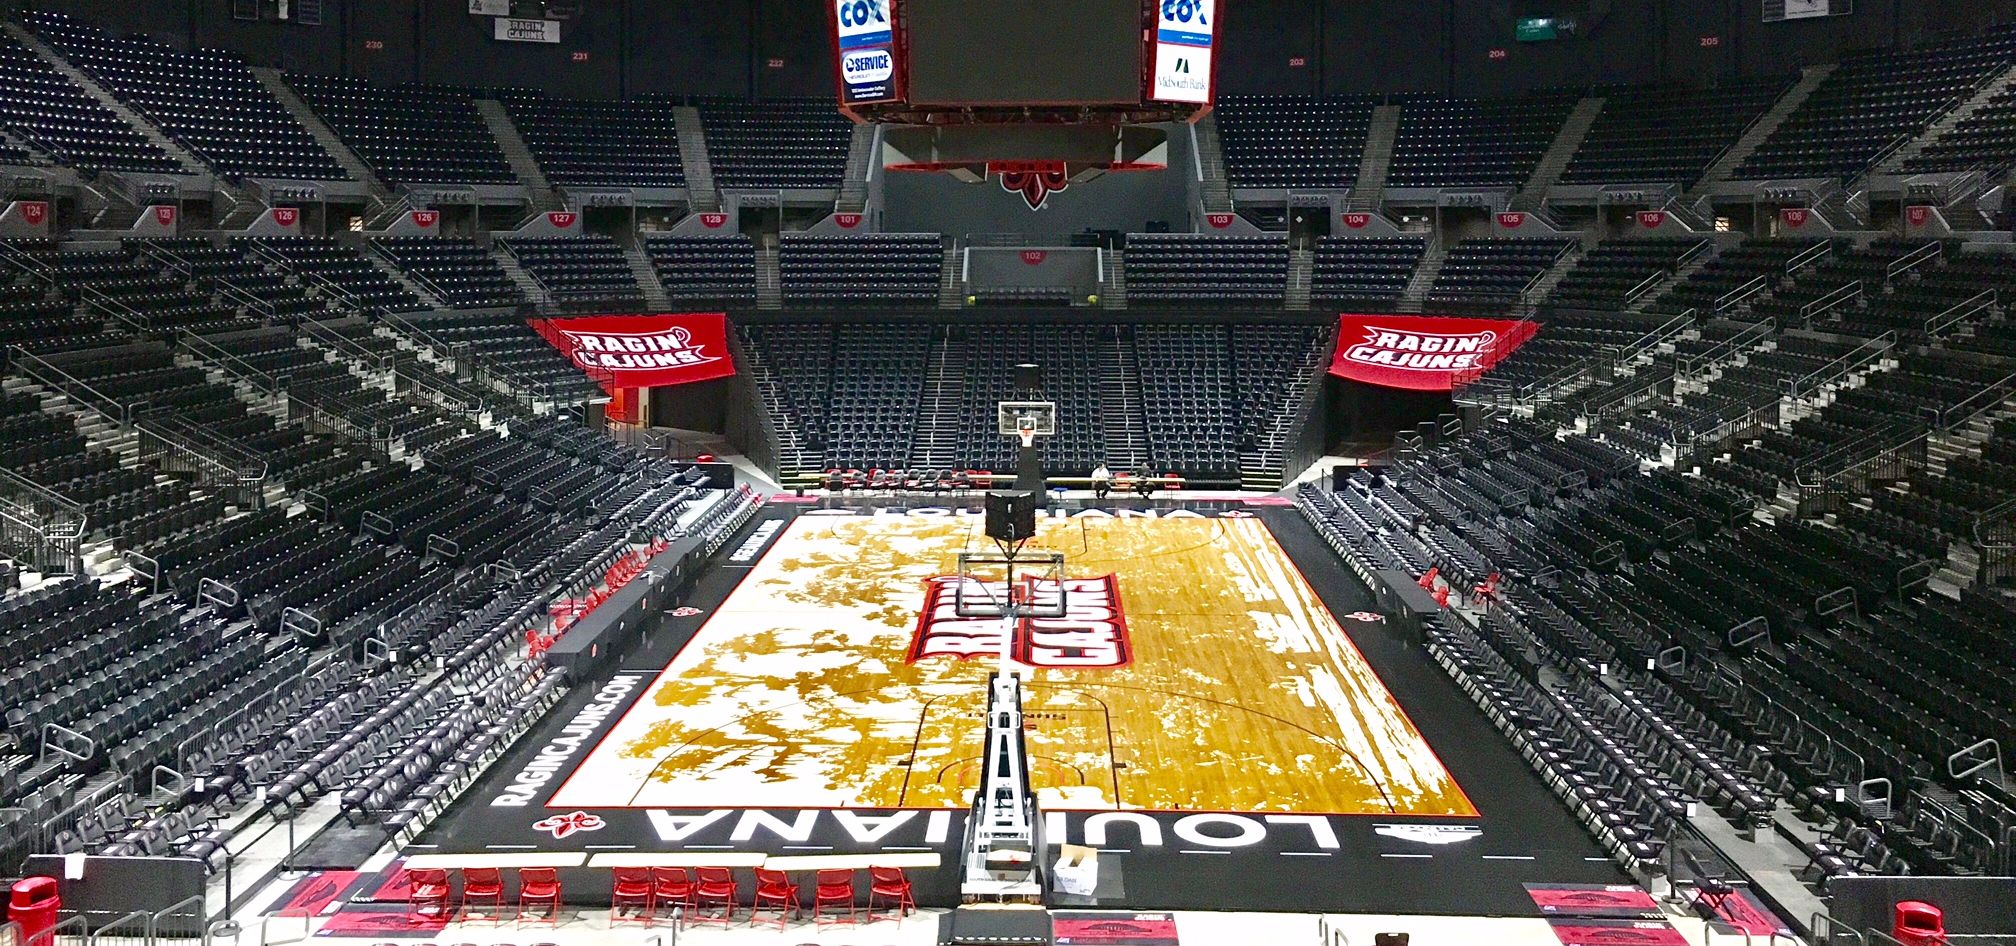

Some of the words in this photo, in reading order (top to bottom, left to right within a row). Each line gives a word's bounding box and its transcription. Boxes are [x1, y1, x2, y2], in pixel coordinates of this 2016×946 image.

[840, 0, 885, 27] COX
[1162, 0, 1207, 25] COX
[508, 31, 544, 40] CAJUNS
[366, 41, 383, 49] 230
[1700, 37, 1718, 46] 205
[573, 52, 588, 60] 231
[1489, 50, 1505, 58] 204
[855, 55, 888, 71] SERVICE
[1290, 58, 1304, 66] 203
[27, 205, 41, 217] 124
[278, 211, 292, 220] 126
[418, 213, 432, 222] 126
[553, 214, 570, 223] 127
[706, 215, 722, 224] 128
[840, 215, 856, 224] 101
[1212, 215, 1227, 224] 103
[1348, 215, 1364, 223] 104
[1502, 215, 1517, 224] 105
[1643, 213, 1659, 222] 106
[1787, 211, 1802, 221] 106
[1026, 252, 1041, 261] 102
[577, 350, 697, 369] CAJUNS
[1350, 346, 1474, 369] CAJUNS
[873, 507, 1206, 519] LOUIANA
[1030, 578, 1120, 665] CAJUNS
[490, 675, 643, 806] RAGINCAJUNS.COM
[646, 809, 1341, 849] LOUIIANA
